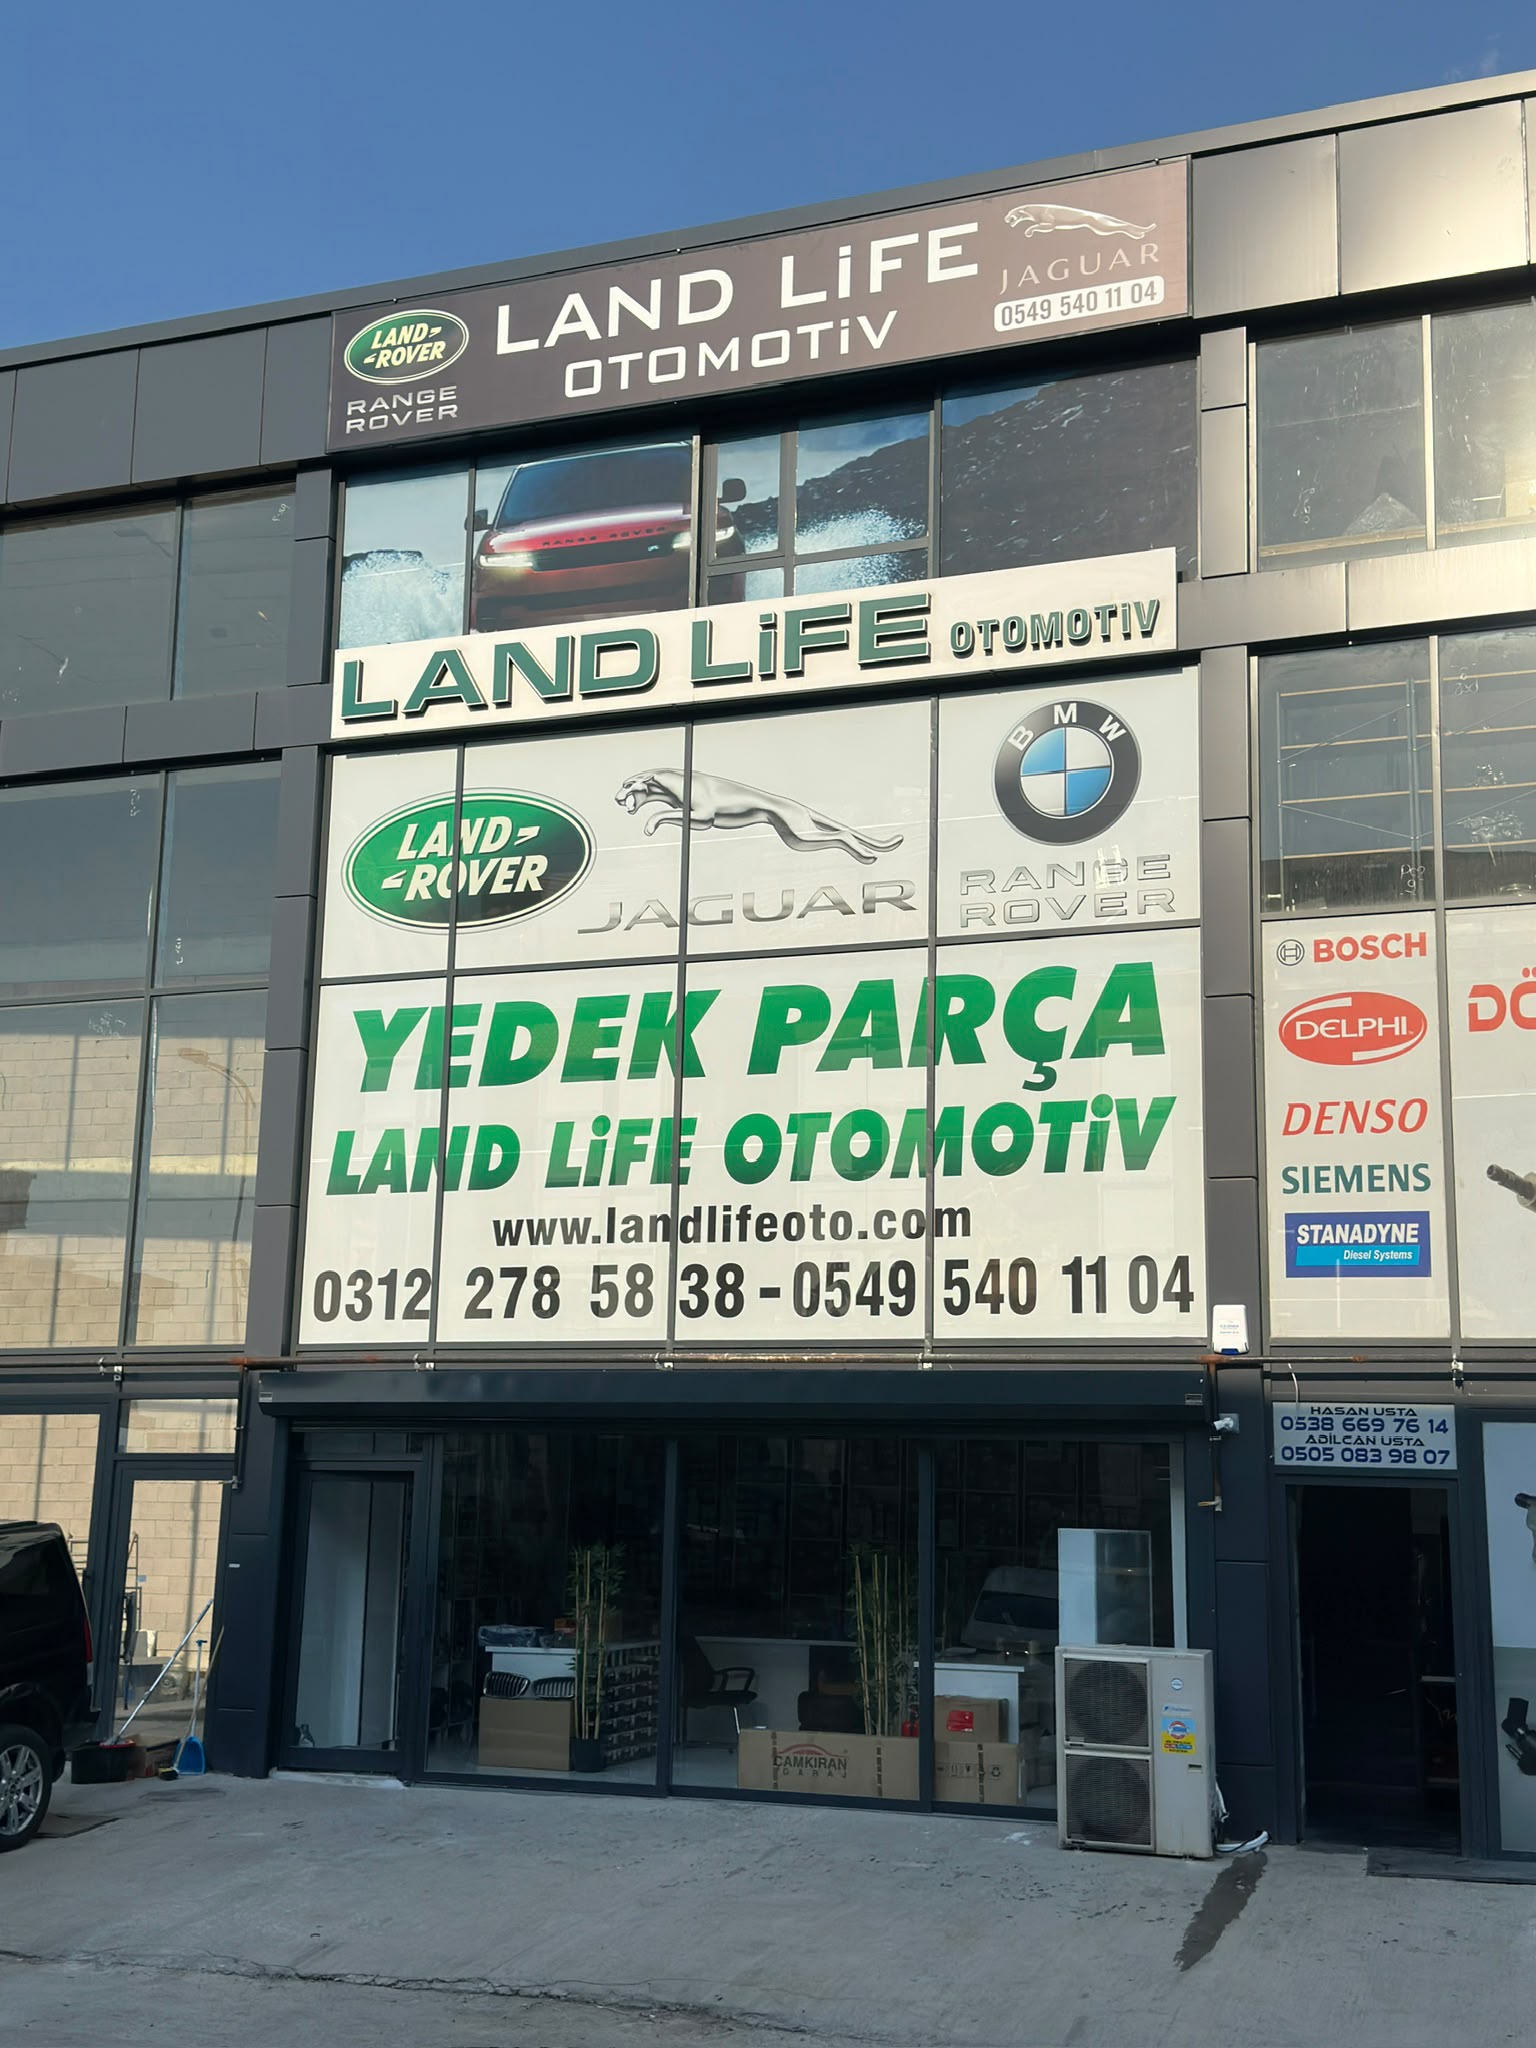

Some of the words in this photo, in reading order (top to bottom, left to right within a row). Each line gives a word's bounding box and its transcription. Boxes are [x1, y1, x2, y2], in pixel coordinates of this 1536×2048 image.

[999, 242, 1159, 295] JAGUAR
[496, 268, 734, 356] LAND
[1001, 298, 1052, 327] 0549
[1060, 291, 1098, 317] 540
[1105, 286, 1121, 309] 11
[1130, 280, 1157, 304] 04
[370, 322, 429, 350] LAND
[374, 341, 446, 369] ROVER
[345, 404, 458, 434] ROVER
[347, 385, 457, 416] RANGE
[542, 535, 597, 547] RANGE
[609, 526, 667, 539] ROVER
[340, 627, 660, 723] LAND
[1007, 702, 1127, 751] BMW
[396, 815, 513, 861] LAND
[404, 854, 549, 902] ROVER
[960, 854, 1171, 895] RANGE
[578, 879, 918, 934] JAGUAR
[960, 888, 1175, 928] ROVER
[1313, 932, 1427, 963] BOSCH
[352, 989, 722, 1093] YEDEK
[746, 961, 1166, 1092] PARÇA
[1295, 1015, 1407, 1040] DELPHI
[1282, 1097, 1428, 1136] DENSO
[326, 1123, 521, 1196] LAND
[1281, 1162, 1431, 1194] SIEMENS
[493, 1203, 971, 1247] www.landlifeoto.com
[1296, 1223, 1420, 1245] STANADYNE
[1343, 1249, 1372, 1260] Diesel
[1373, 1249, 1413, 1262] Systems
[313, 1267, 432, 1323] 0312
[464, 1264, 561, 1320] 278
[590, 1262, 654, 1319] 58
[679, 1262, 744, 1319] 38
[793, 1258, 916, 1318] 0549
[943, 1256, 1037, 1316] 540
[1061, 1254, 1107, 1315] 11
[1128, 1254, 1194, 1315] 04
[1280, 1416, 1334, 1431] 0538
[1342, 1417, 1385, 1432] 669
[1393, 1418, 1420, 1433] 76
[1428, 1419, 1449, 1434] 14
[1310, 1406, 1369, 1417] HASAN
[1373, 1407, 1418, 1417] USTA
[1281, 1446, 1335, 1462] 0505
[1341, 1447, 1382, 1463] 083
[1388, 1449, 1417, 1464] 98
[1423, 1450, 1450, 1465] 07
[1381, 1436, 1425, 1447] USTA
